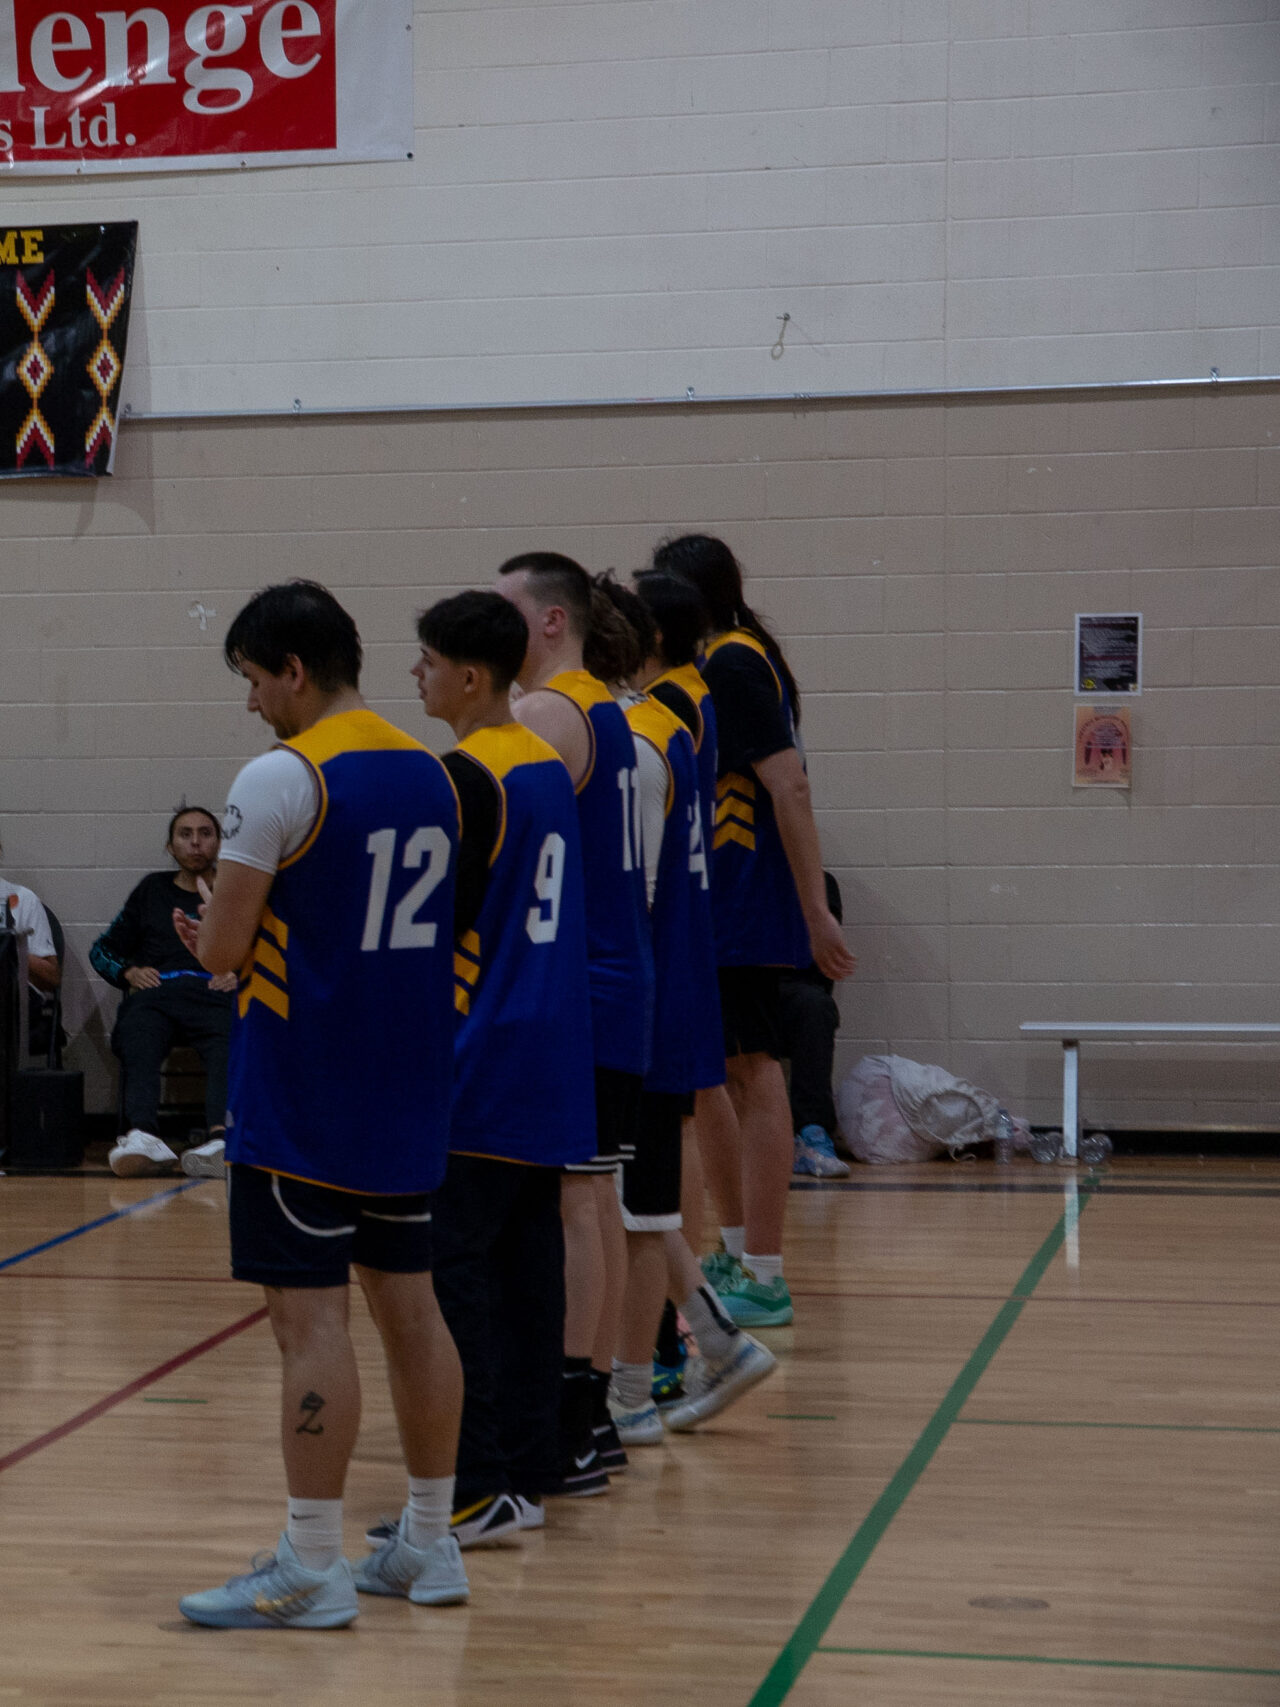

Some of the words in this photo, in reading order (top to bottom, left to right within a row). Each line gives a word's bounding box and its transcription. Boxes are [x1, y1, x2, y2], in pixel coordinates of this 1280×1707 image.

[30, 101, 137, 150] Ltd.
[360, 825, 453, 953] 12
[525, 832, 567, 945] 9
